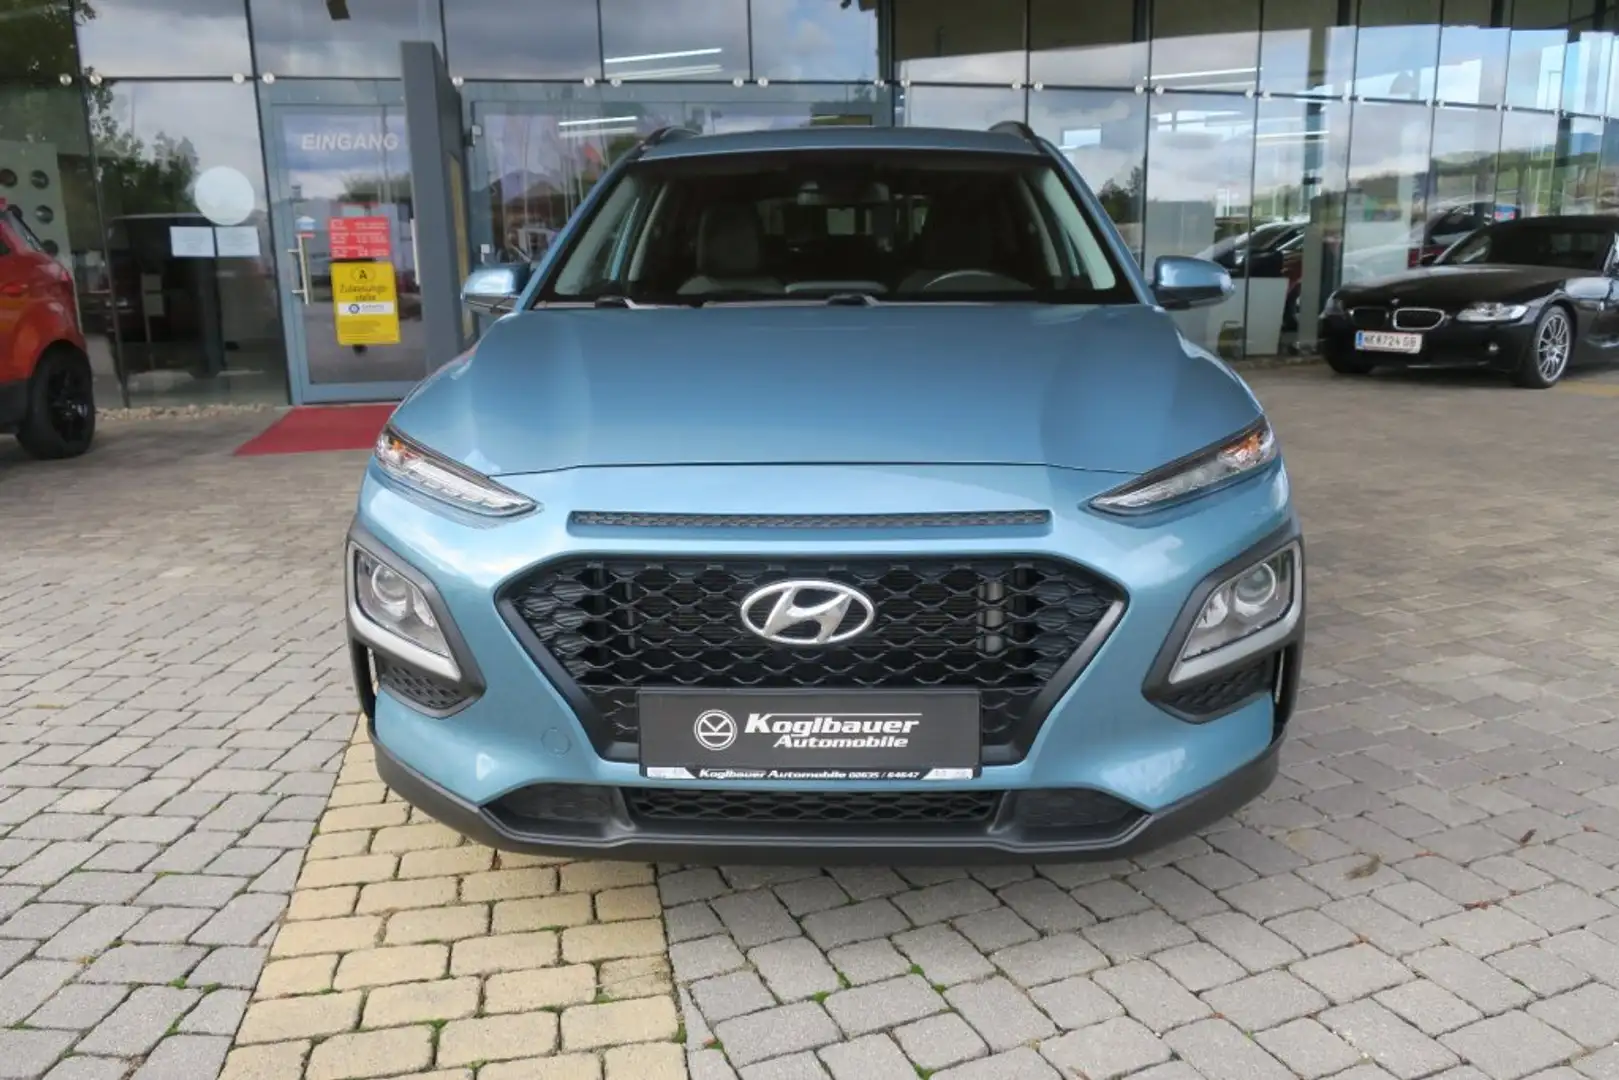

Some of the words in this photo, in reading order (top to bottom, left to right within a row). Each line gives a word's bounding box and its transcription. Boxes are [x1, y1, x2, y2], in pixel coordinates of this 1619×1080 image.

[300, 131, 399, 151] EINGANG
[744, 712, 920, 737] Koglbauer
[773, 734, 909, 749] Automobile
[699, 767, 766, 779] Koglbauer
[767, 769, 847, 779] Automobile
